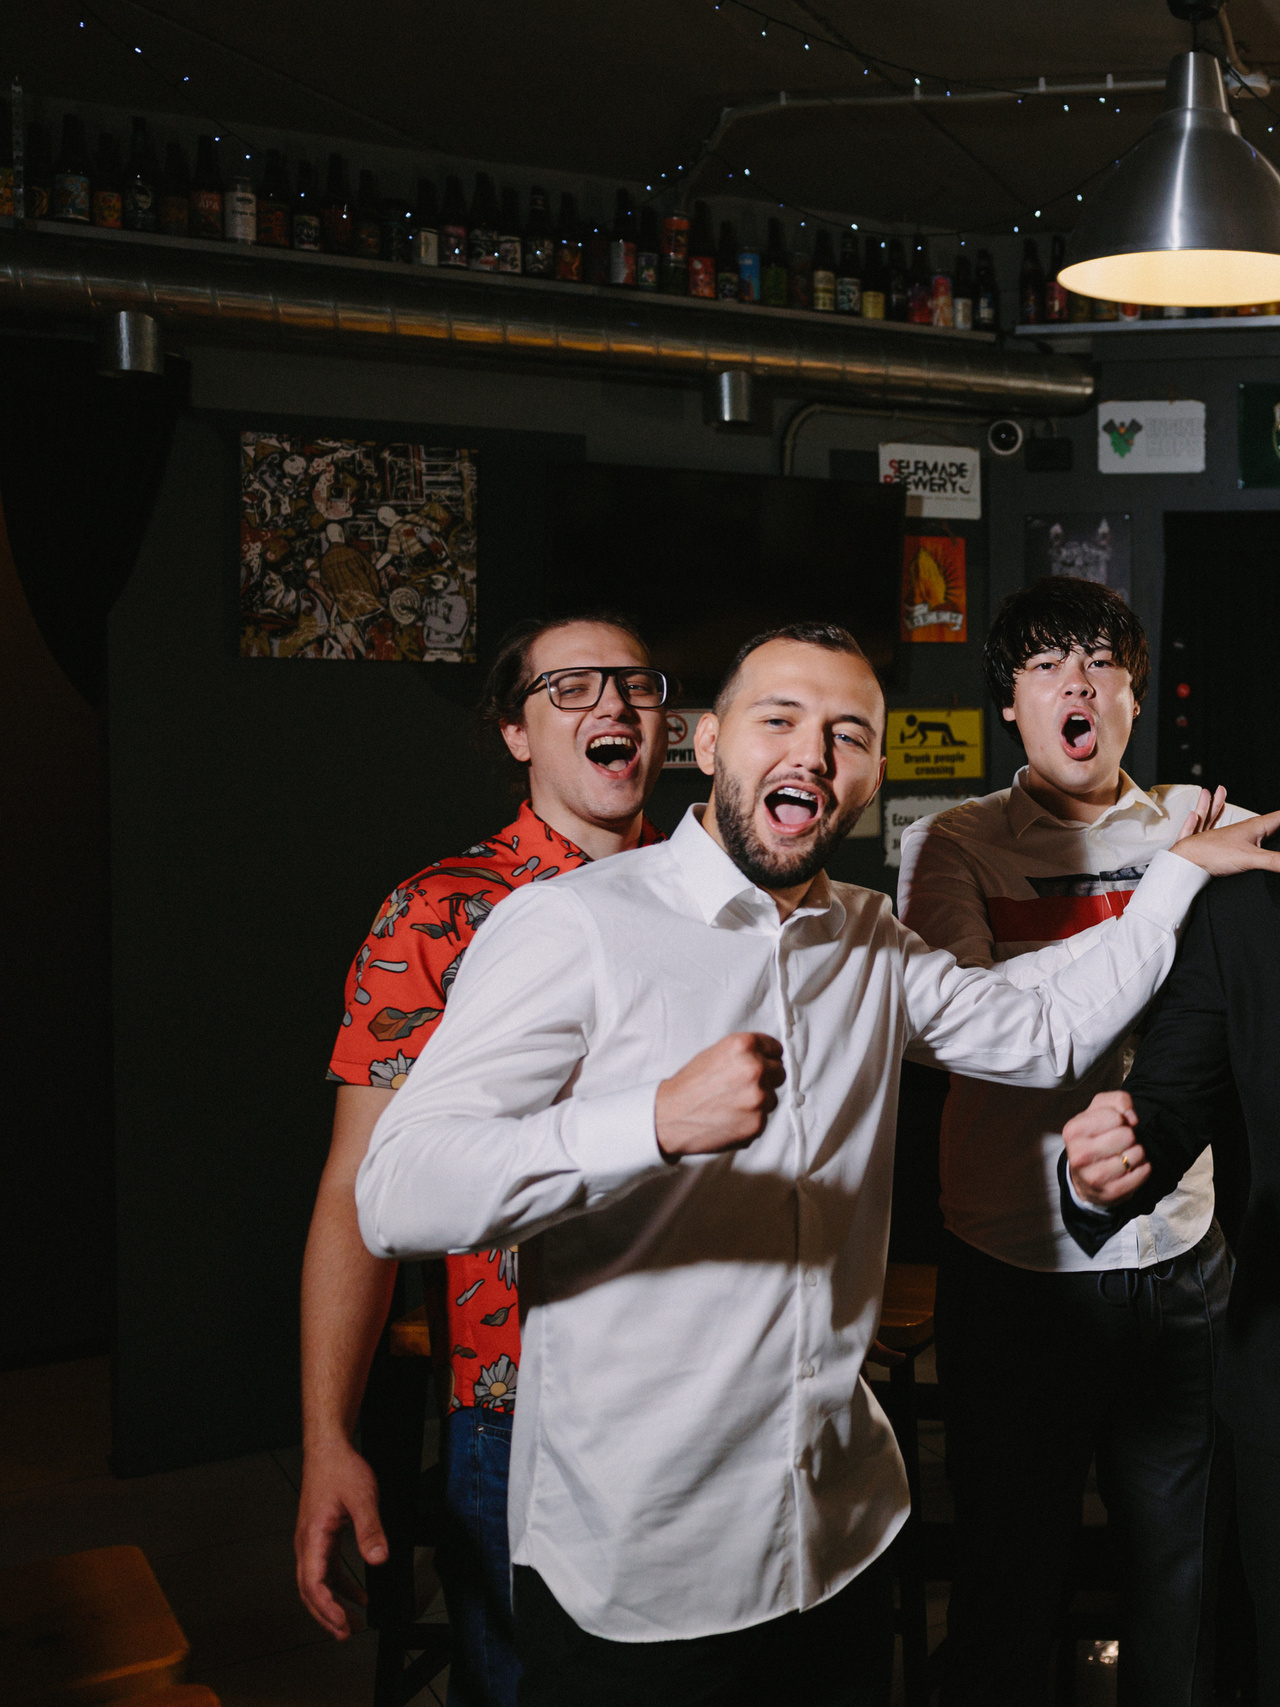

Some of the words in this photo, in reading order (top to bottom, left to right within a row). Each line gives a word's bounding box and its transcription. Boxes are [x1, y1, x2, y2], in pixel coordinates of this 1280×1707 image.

[889, 458, 968, 479] SELFMADE
[904, 752, 930, 763] Drunk
[933, 753, 966, 764] people
[915, 766, 955, 776] crossing
